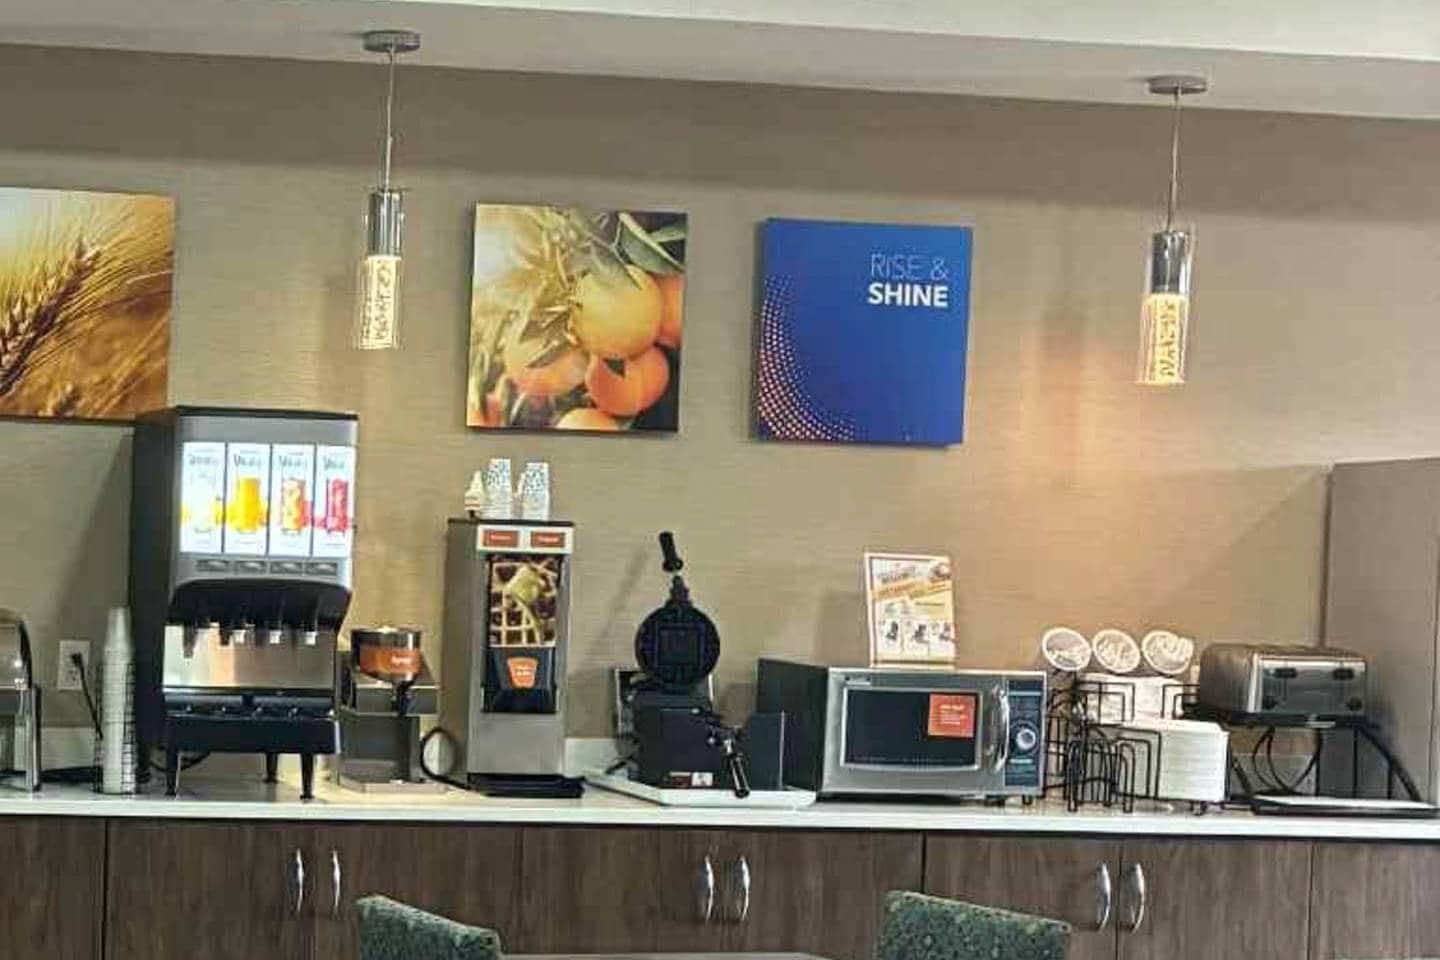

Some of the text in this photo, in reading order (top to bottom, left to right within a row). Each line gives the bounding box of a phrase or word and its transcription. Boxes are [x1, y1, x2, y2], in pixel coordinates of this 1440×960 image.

[870, 253, 952, 281] RISE &
[868, 282, 949, 307] SHINE
